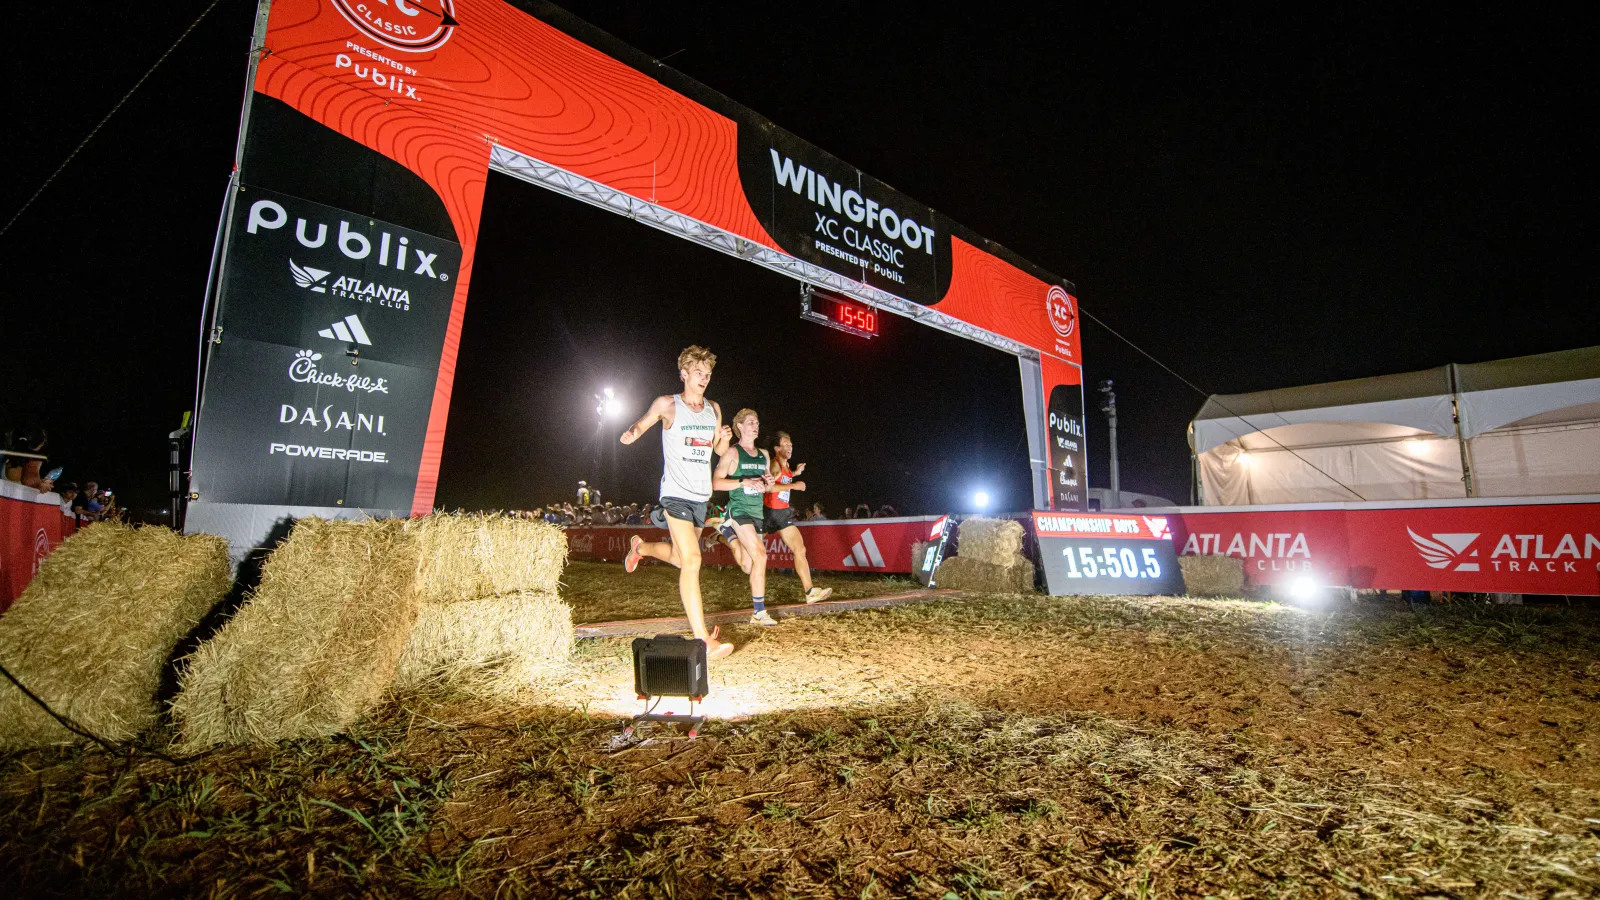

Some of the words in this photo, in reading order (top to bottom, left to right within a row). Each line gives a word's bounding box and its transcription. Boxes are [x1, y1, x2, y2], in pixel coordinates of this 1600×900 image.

[356, 3, 417, 35] CLASSIC
[346, 41, 404, 71] PRESENTED
[405, 66, 418, 77] BY
[769, 147, 935, 256] WINGFOOT
[814, 211, 839, 240] XC
[843, 226, 904, 269] CLASSIC
[815, 240, 859, 266] PRESENTED
[859, 257, 870, 270] BY
[332, 275, 410, 305] ATLANTA
[332, 288, 373, 304] TRACK
[379, 298, 410, 311] CLUB
[1054, 303, 1067, 321] XC
[691, 448, 706, 456] 330
[1036, 516, 1113, 534] CHAMPIONSHIP
[1113, 518, 1141, 535] BOYS
[1180, 532, 1312, 559] ATLANTA
[1062, 546, 1161, 579] 15:50.5
[1257, 560, 1312, 572] CLUB
[1491, 561, 1577, 573] TRACK
